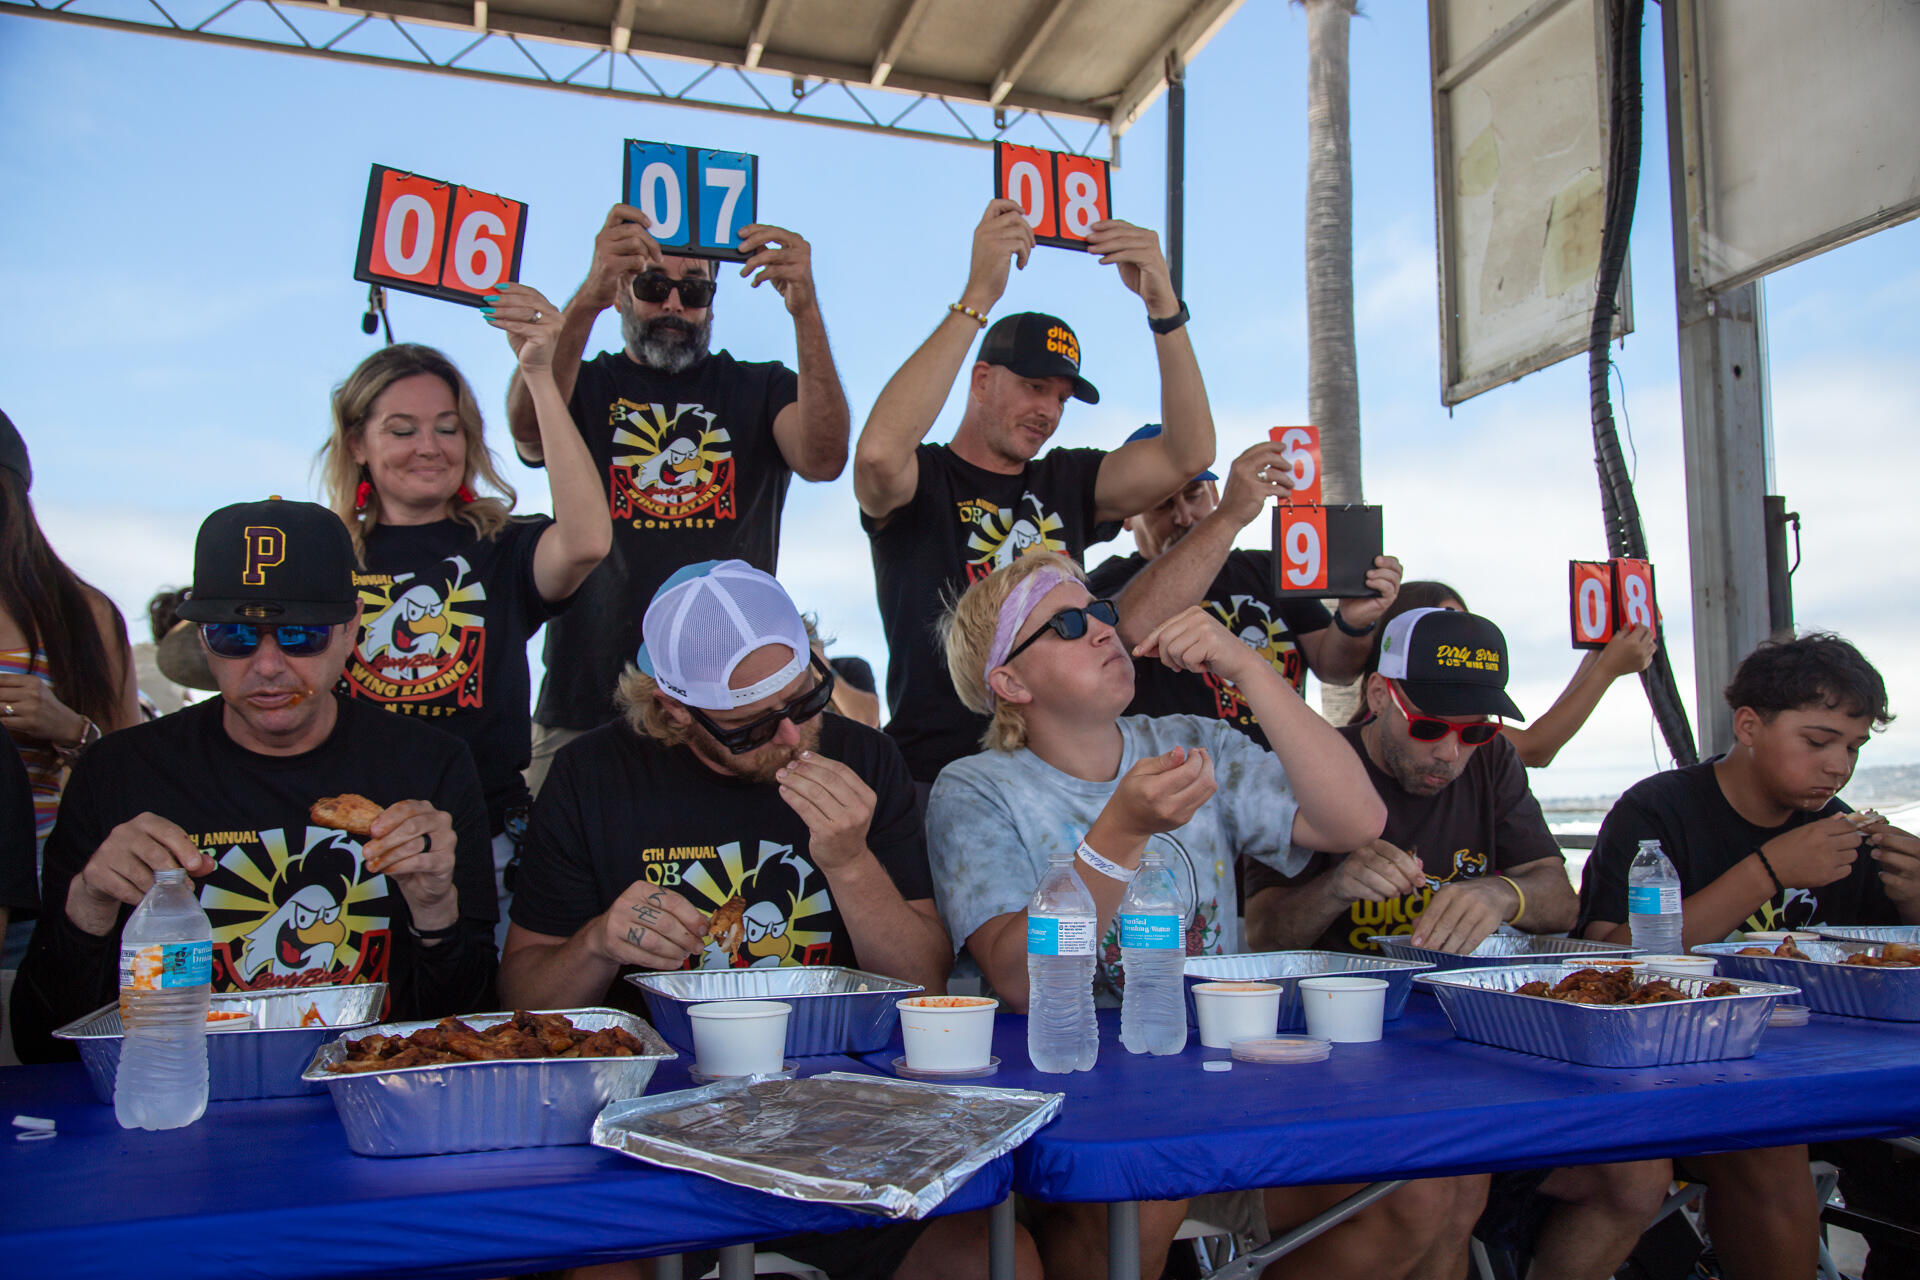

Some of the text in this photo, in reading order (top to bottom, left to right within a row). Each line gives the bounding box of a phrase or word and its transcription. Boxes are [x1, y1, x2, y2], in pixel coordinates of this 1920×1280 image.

[639, 162, 747, 244] 07
[1008, 161, 1100, 238] 08
[383, 194, 506, 290] 06
[1281, 428, 1315, 490] 6
[627, 488, 666, 514] WING
[669, 484, 721, 515] EATING
[632, 518, 716, 529] CONTEST
[243, 526, 286, 585] P
[1285, 522, 1321, 587] 9
[1579, 574, 1651, 639] 08
[351, 660, 468, 697] WING EATING
[384, 703, 457, 717] NTEST
[204, 831, 259, 846] ANNUAL
[642, 846, 717, 861] 6TH ANNUAL
[645, 862, 682, 886] OB
